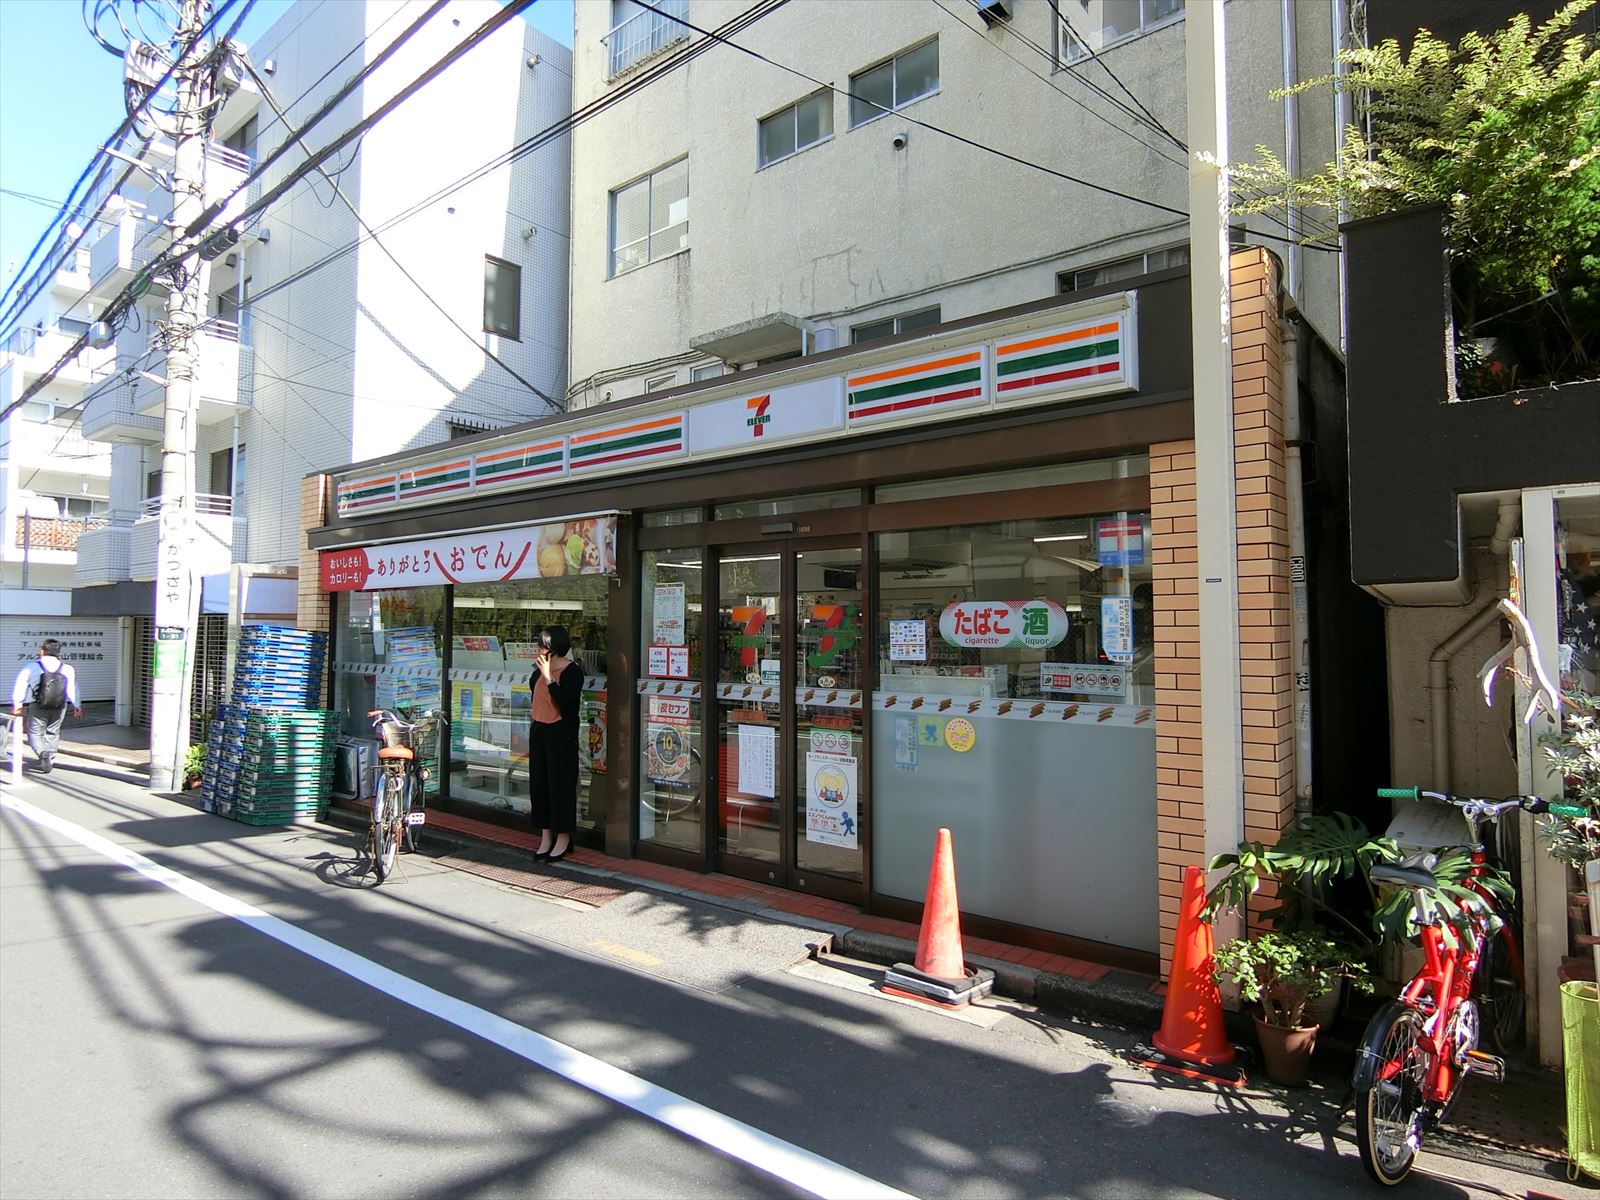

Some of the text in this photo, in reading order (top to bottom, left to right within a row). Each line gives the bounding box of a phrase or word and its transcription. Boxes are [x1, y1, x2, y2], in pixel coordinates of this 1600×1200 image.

[747, 394, 770, 437] 7
[377, 541, 512, 576] ありがとう おでん
[954, 607, 1048, 635] たばこ 酒
[965, 637, 1050, 645] cigarette liquor
